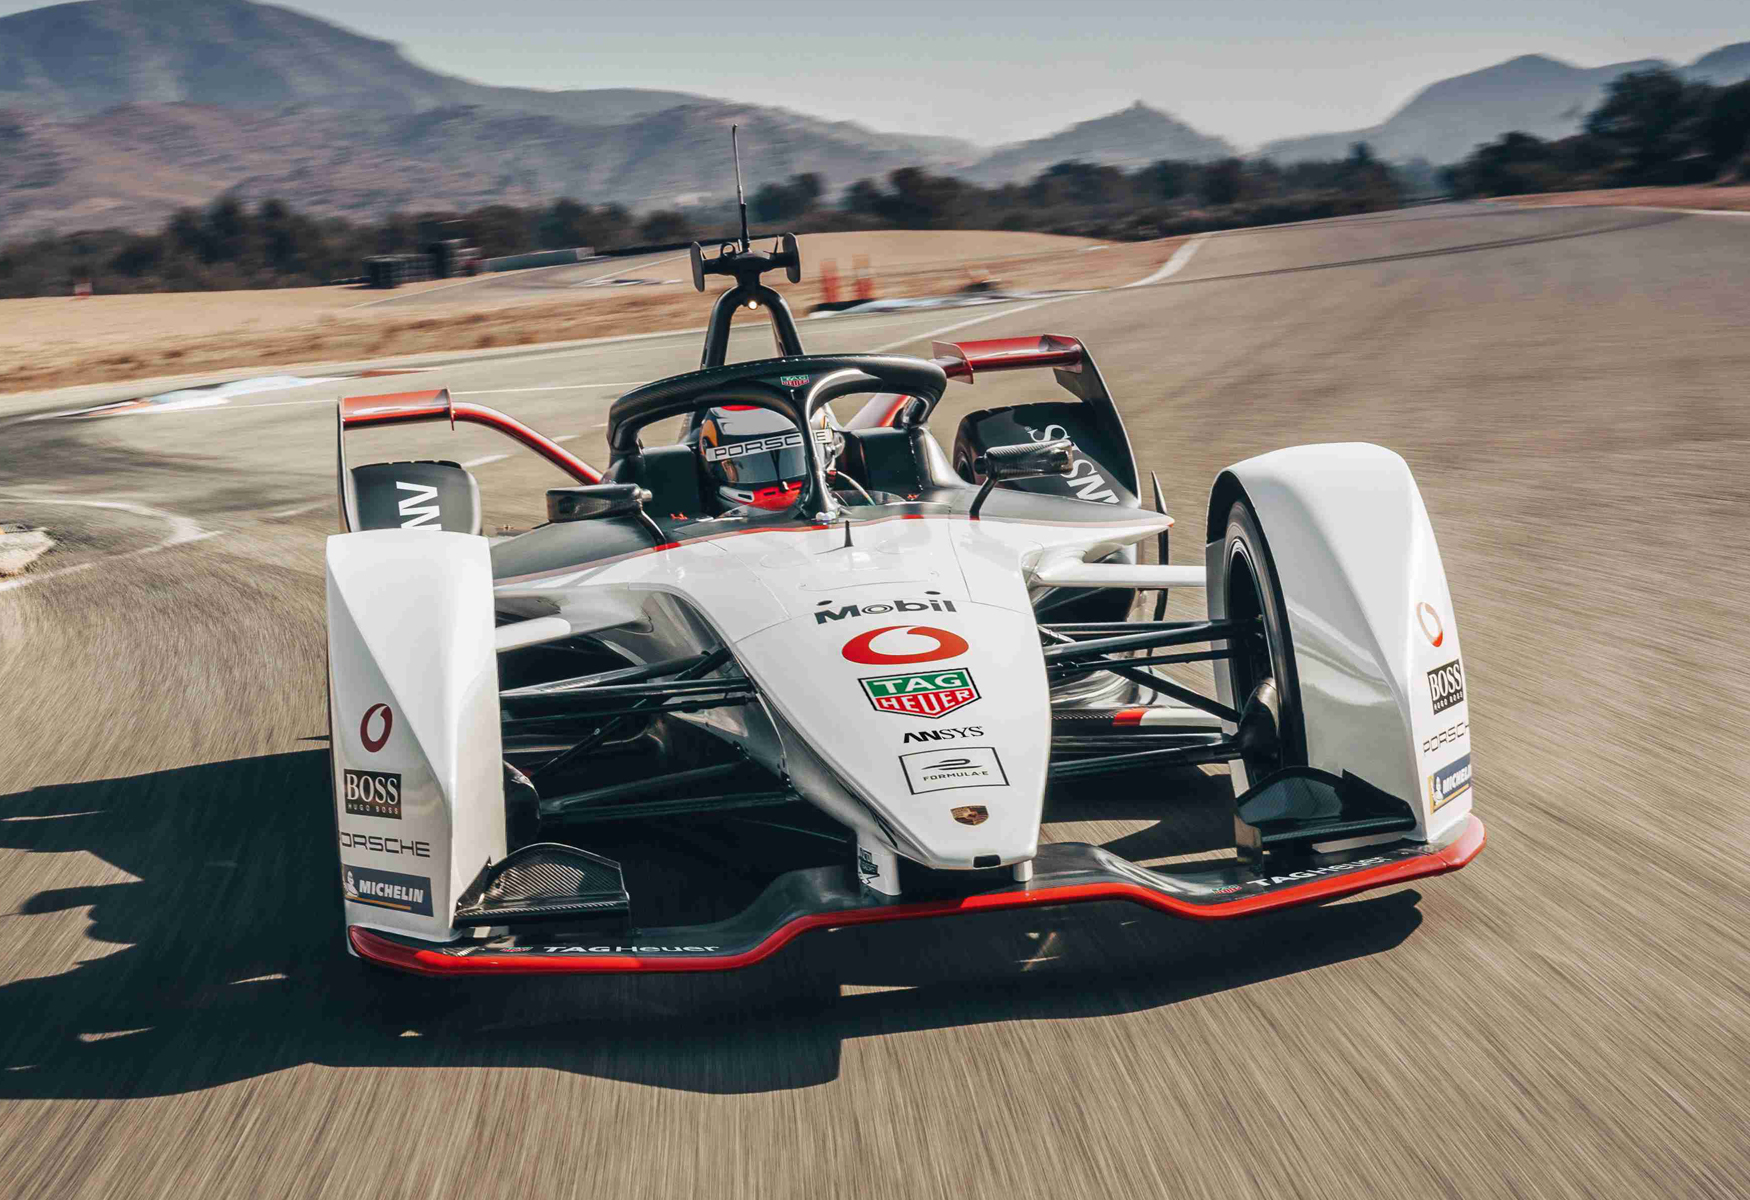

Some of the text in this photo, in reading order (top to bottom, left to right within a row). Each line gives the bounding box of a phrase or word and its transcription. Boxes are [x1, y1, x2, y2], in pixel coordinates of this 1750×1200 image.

[714, 431, 826, 459] PORSCE
[814, 599, 957, 625] Mobil
[873, 674, 962, 694] TAG
[1428, 663, 1463, 701] BOSS
[880, 689, 971, 714] HEUER
[903, 725, 984, 743] ANSYS
[346, 773, 399, 805] BOSS
[347, 803, 399, 815] HUGO BOSS
[338, 831, 431, 858] ORSCHE
[359, 879, 424, 903] MICHELIN
